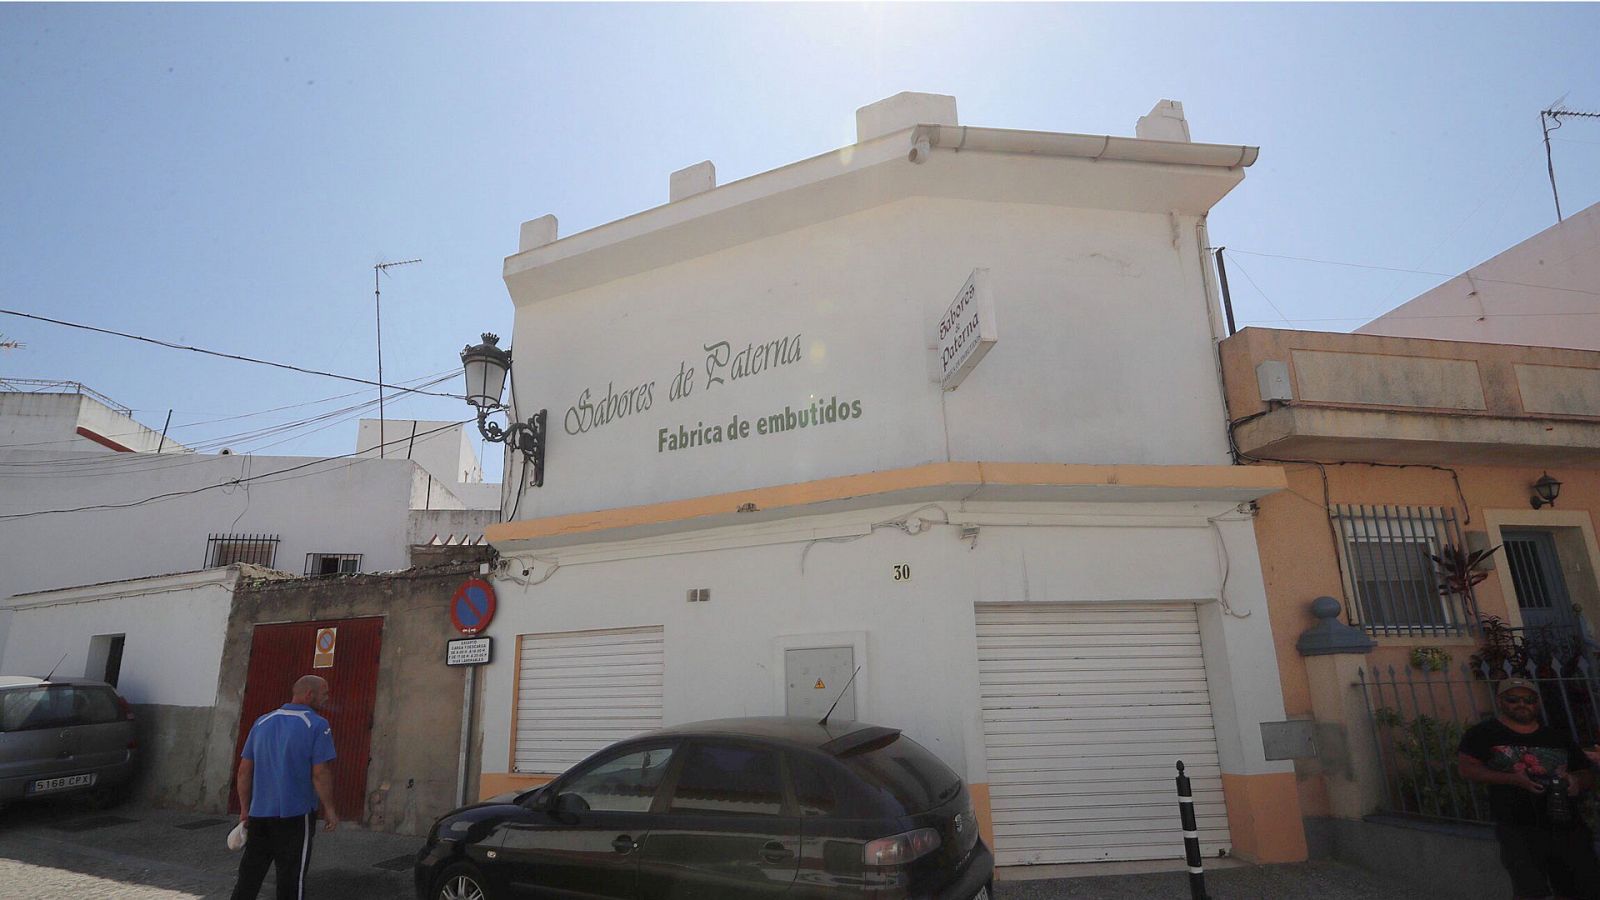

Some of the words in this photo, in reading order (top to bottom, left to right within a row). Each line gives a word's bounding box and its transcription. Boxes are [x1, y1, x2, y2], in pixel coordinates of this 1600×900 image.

[940, 284, 975, 340] Sabores
[941, 313, 980, 372] Paterna
[564, 381, 655, 435] Sabores
[669, 361, 694, 402] de
[704, 333, 801, 390] Paterna
[658, 421, 723, 452] Fabrica
[727, 415, 750, 441] de
[756, 397, 862, 435] embutidos
[894, 564, 910, 580] 30
